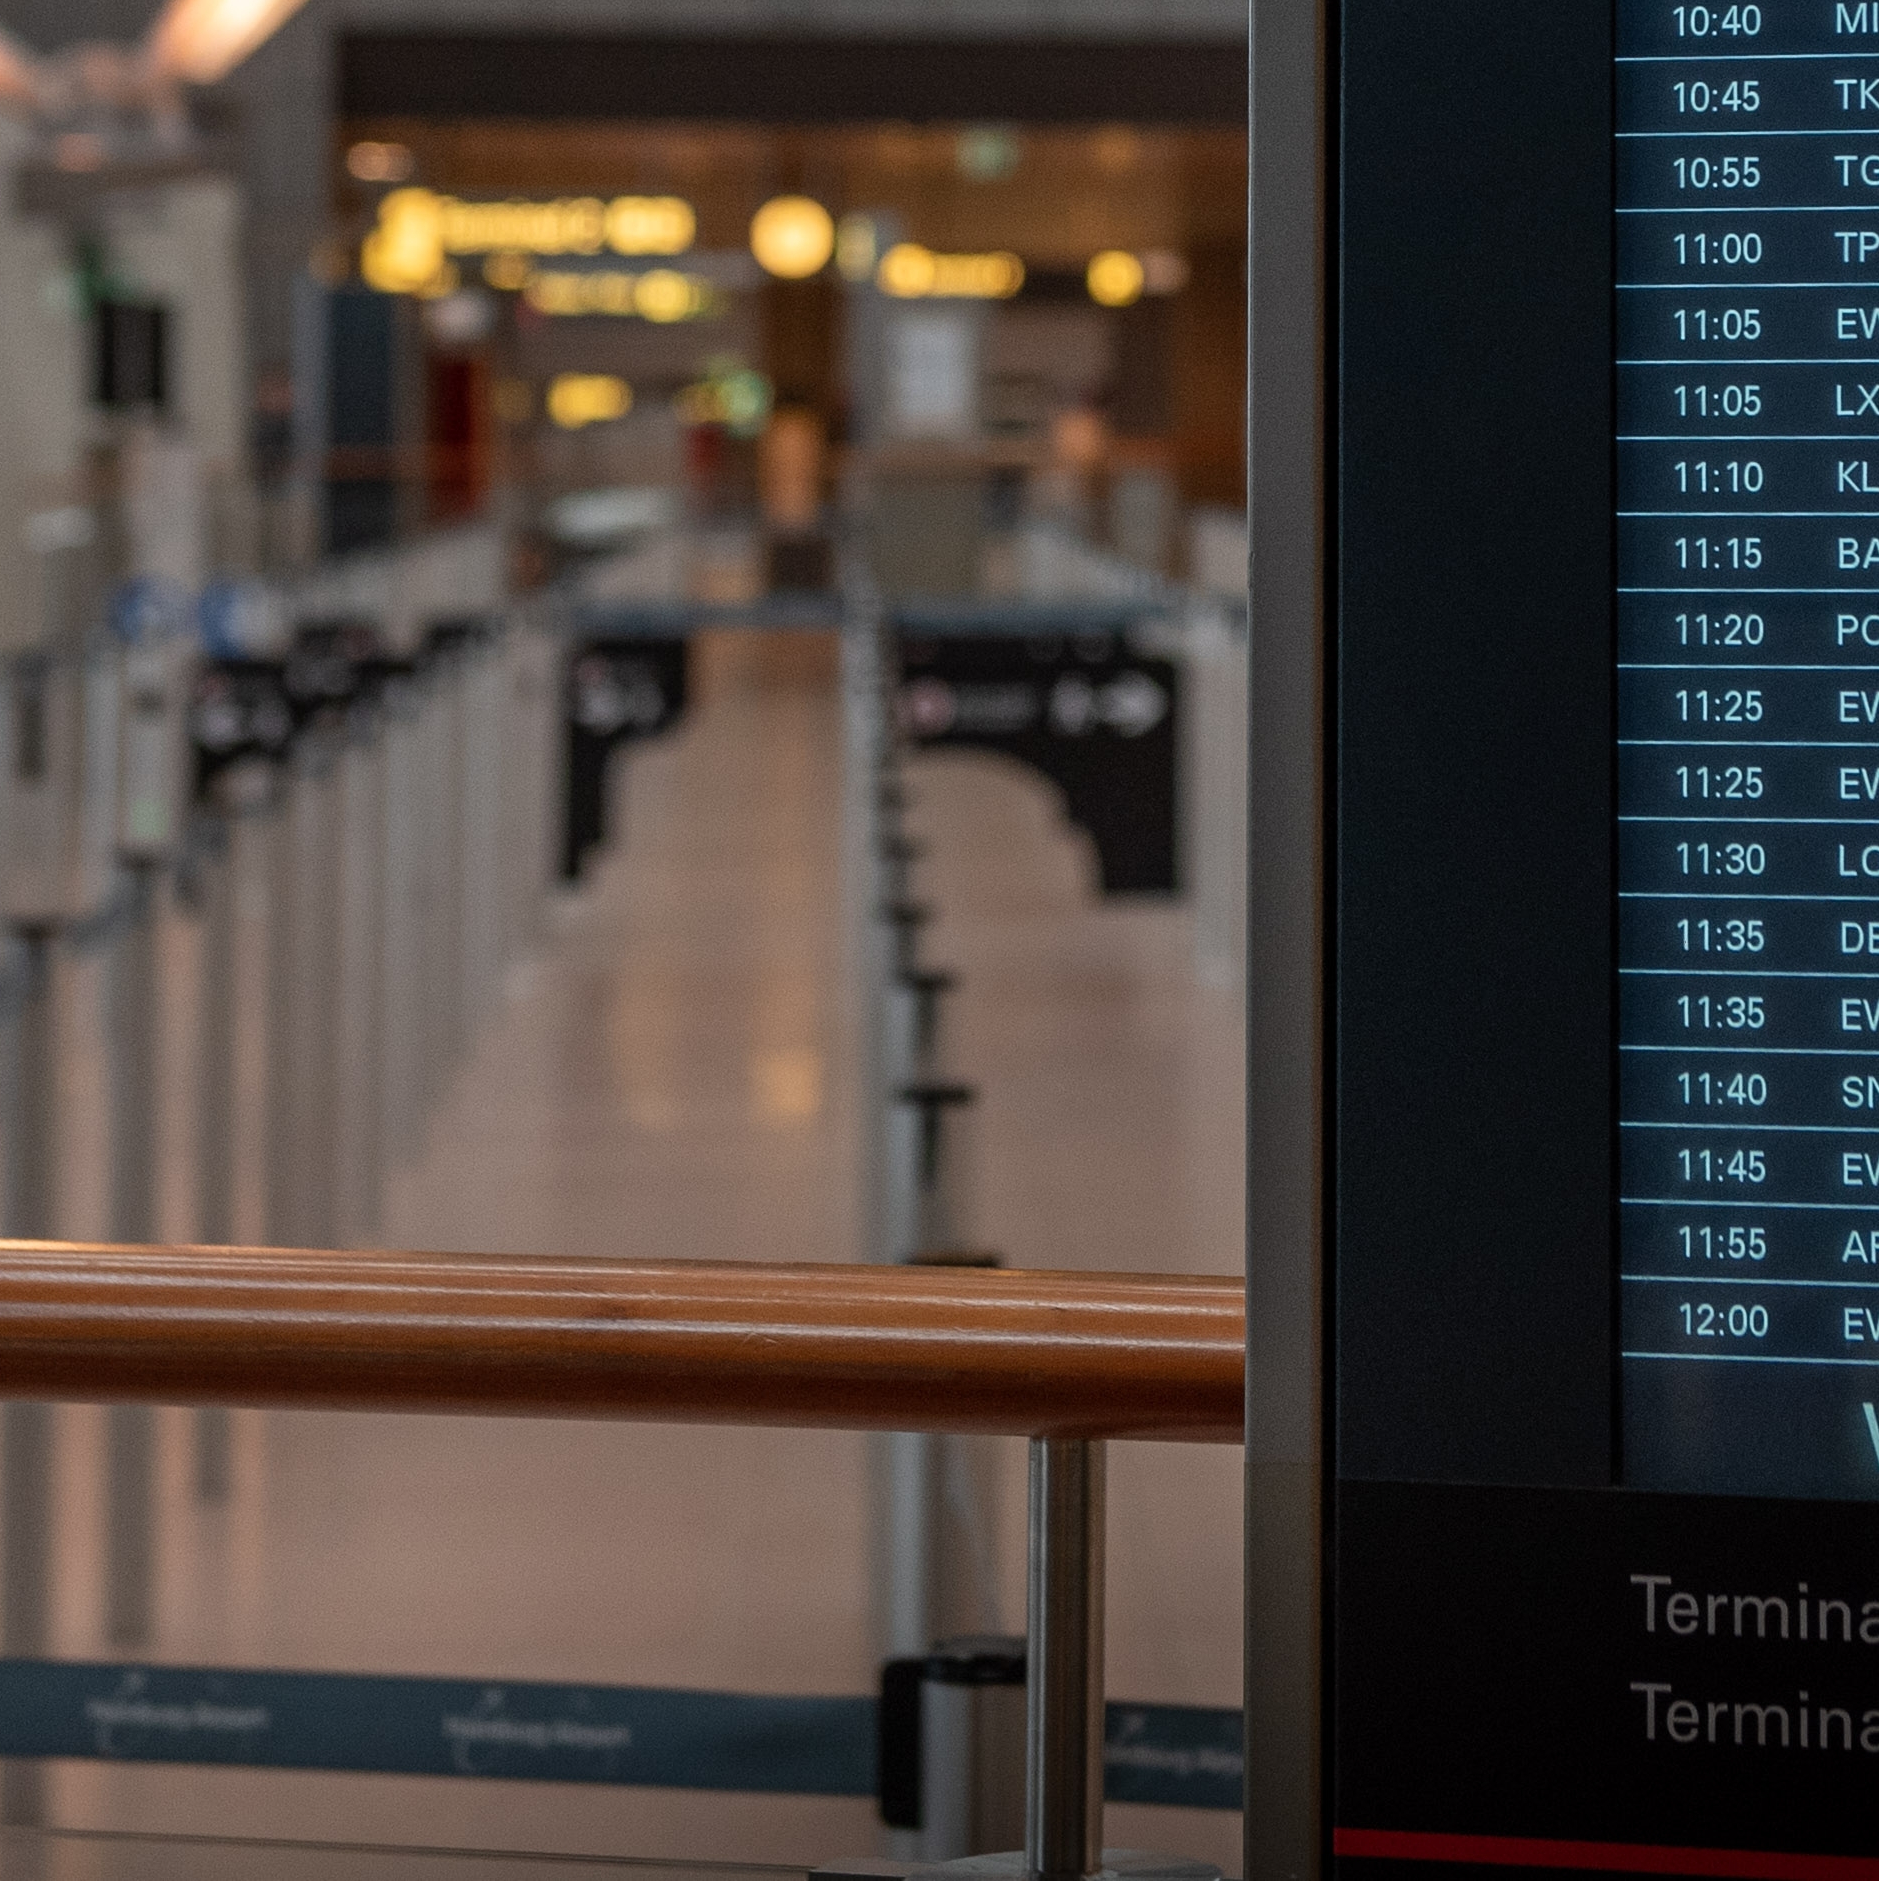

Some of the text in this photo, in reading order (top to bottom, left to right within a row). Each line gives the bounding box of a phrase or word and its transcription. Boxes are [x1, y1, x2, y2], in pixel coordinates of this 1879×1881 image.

[1672, 3, 1762, 38] 10:40
[1834, 1, 1879, 35] MI
[1672, 79, 1761, 114] 10:45
[1672, 231, 1763, 266] 11:00
[1673, 383, 1763, 417] 11:05
[1674, 536, 1763, 570] 11:15
[1674, 612, 1765, 647] 11:20
[1674, 689, 1764, 723] 11:25
[1676, 917, 1766, 953] 11:35
[1676, 994, 1766, 1030] 11:35
[1677, 1224, 1767, 1261] 11:55
[1678, 1302, 1770, 1339] 12:00
